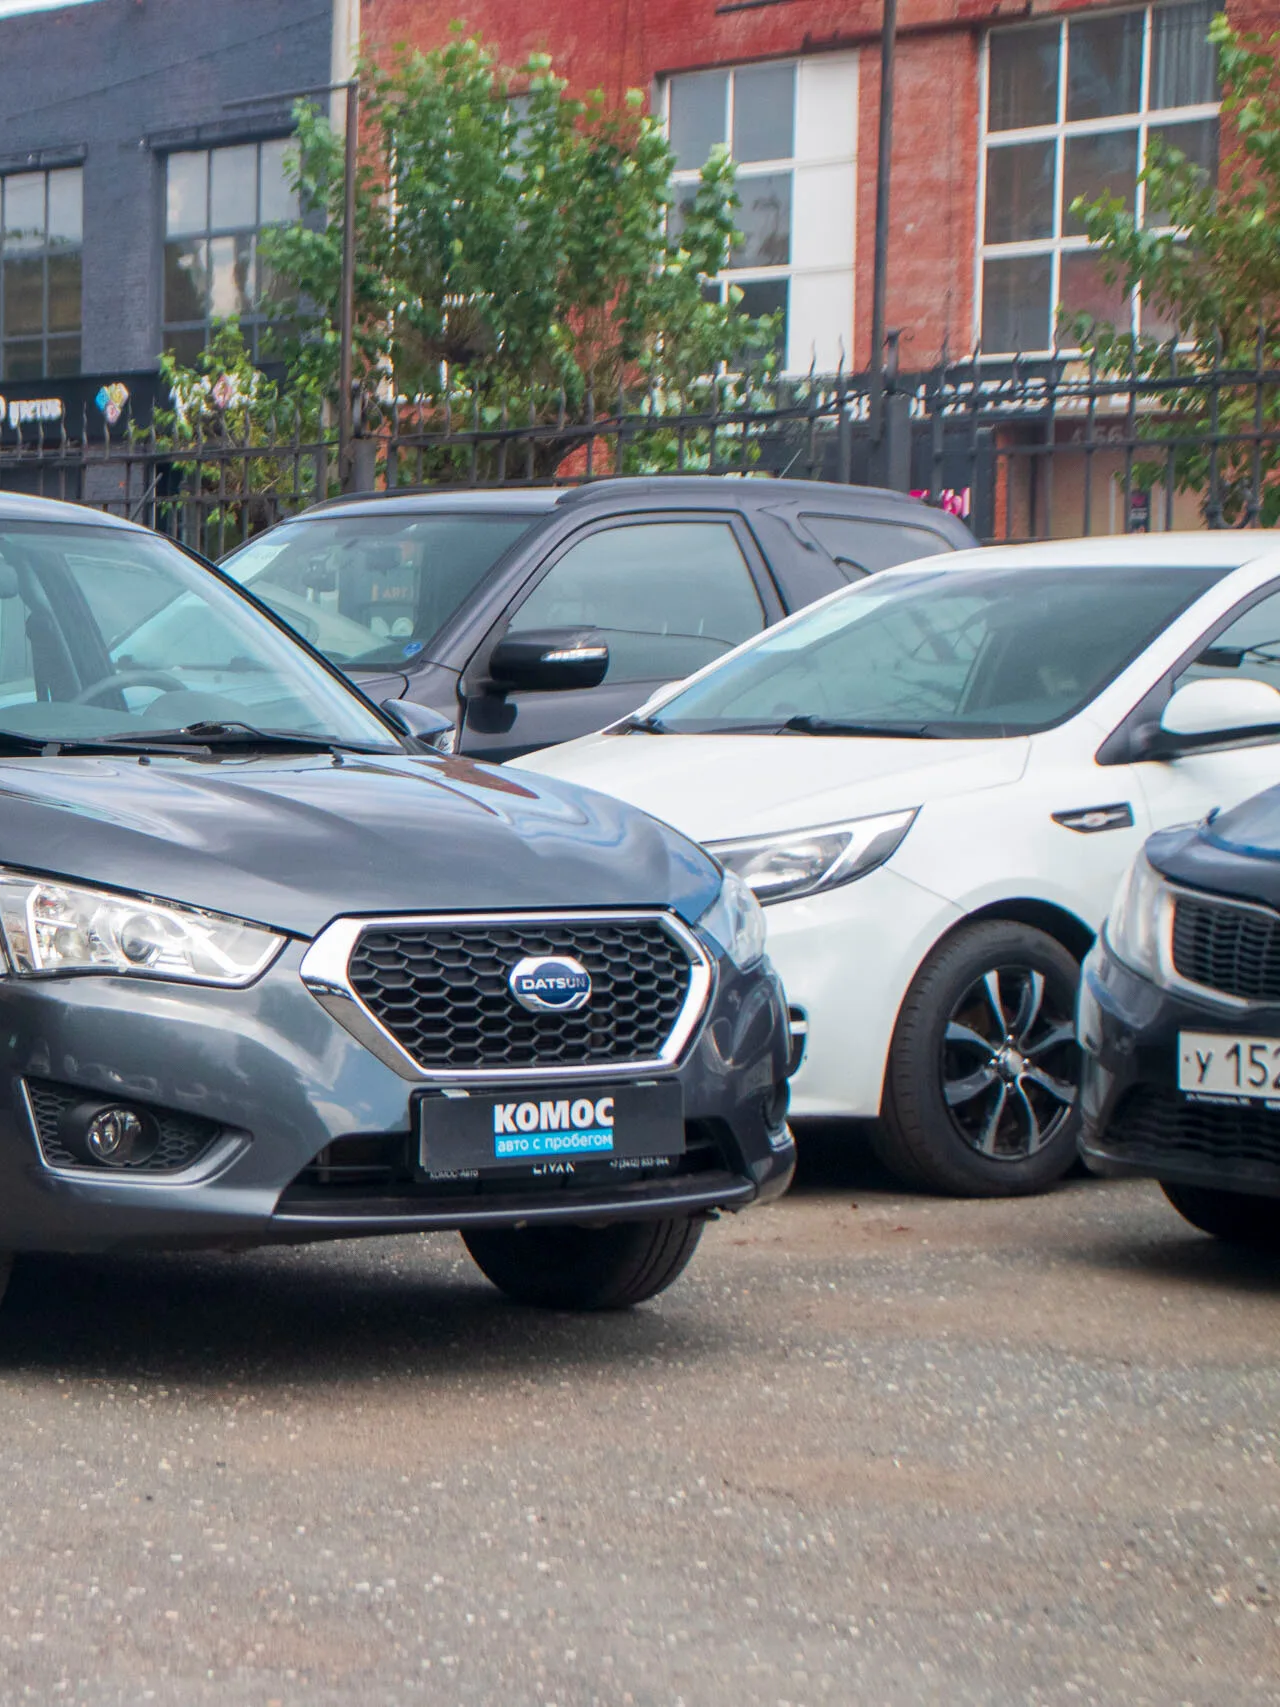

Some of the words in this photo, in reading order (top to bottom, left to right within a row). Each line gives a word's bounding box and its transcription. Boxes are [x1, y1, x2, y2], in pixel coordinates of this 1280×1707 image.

[521, 977, 586, 990] DATSUN
[494, 1097, 614, 1133] КОМОС
[498, 1139, 529, 1153] авто
[533, 1138, 541, 1150] с
[545, 1133, 613, 1151] пробегом
